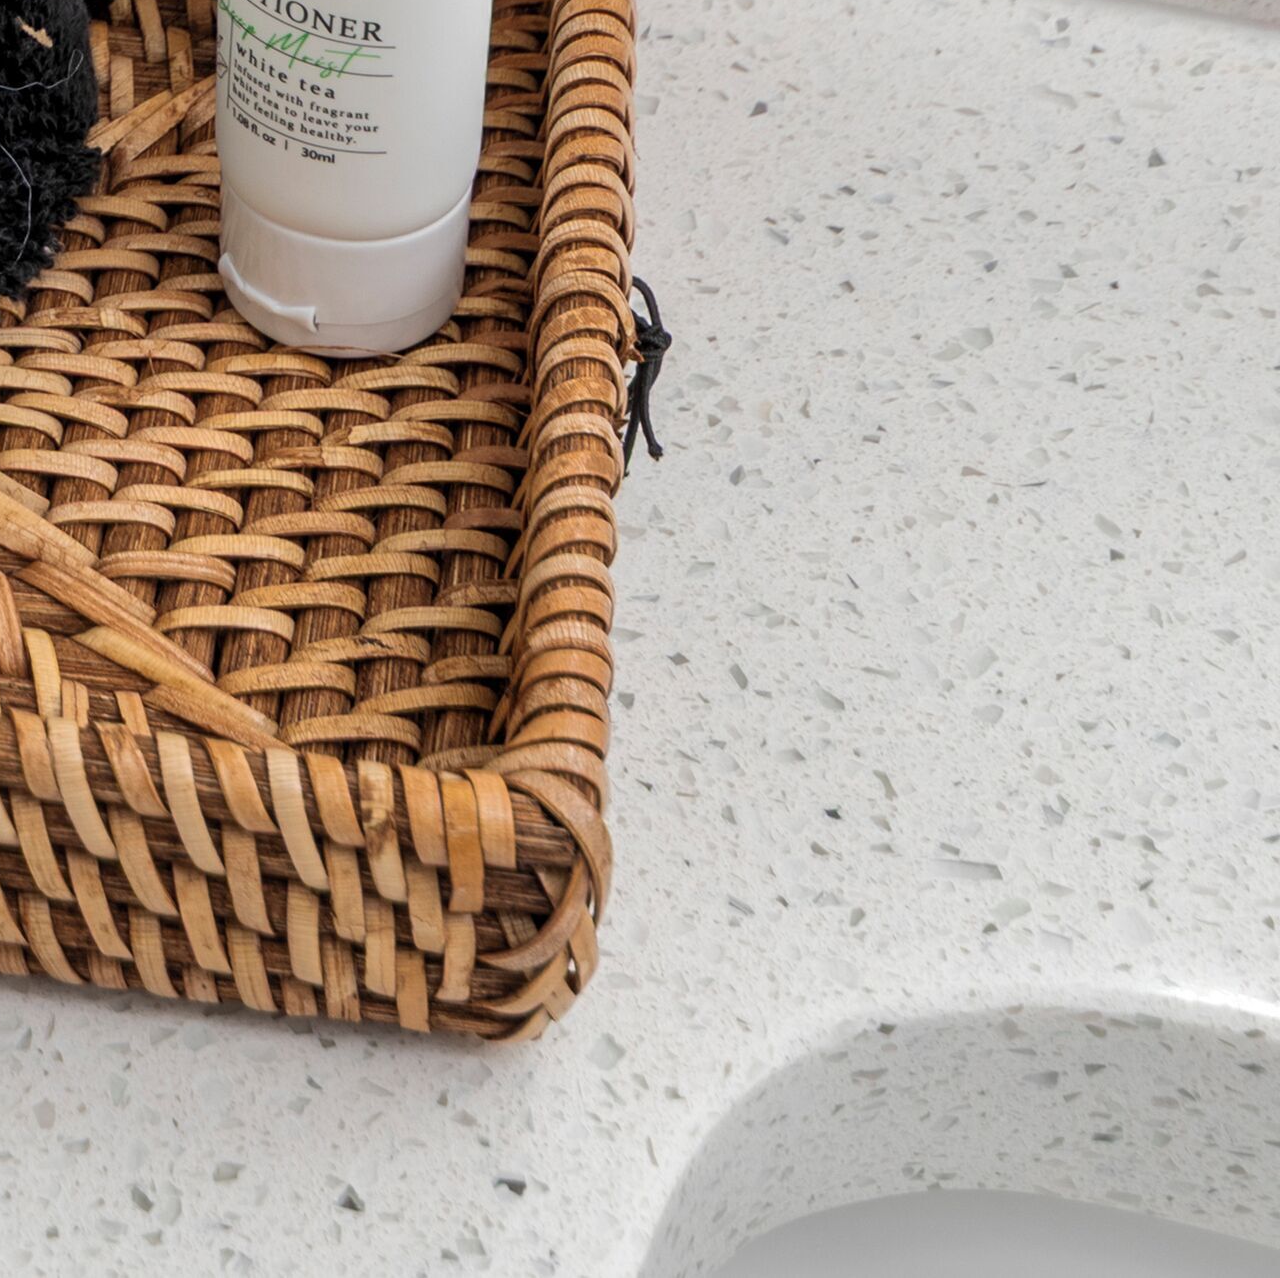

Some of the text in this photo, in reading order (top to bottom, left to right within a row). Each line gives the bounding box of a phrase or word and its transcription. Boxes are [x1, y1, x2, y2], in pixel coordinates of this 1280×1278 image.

[236, 42, 336, 99] white tea
[232, 83, 357, 145] hair feeling healthy.
[233, 73, 379, 133] white tea to leave your
[275, 89, 303, 107] with
[310, 102, 370, 120] fragrant
[262, 132, 276, 146] oz
[301, 147, 336, 164] 30ml
